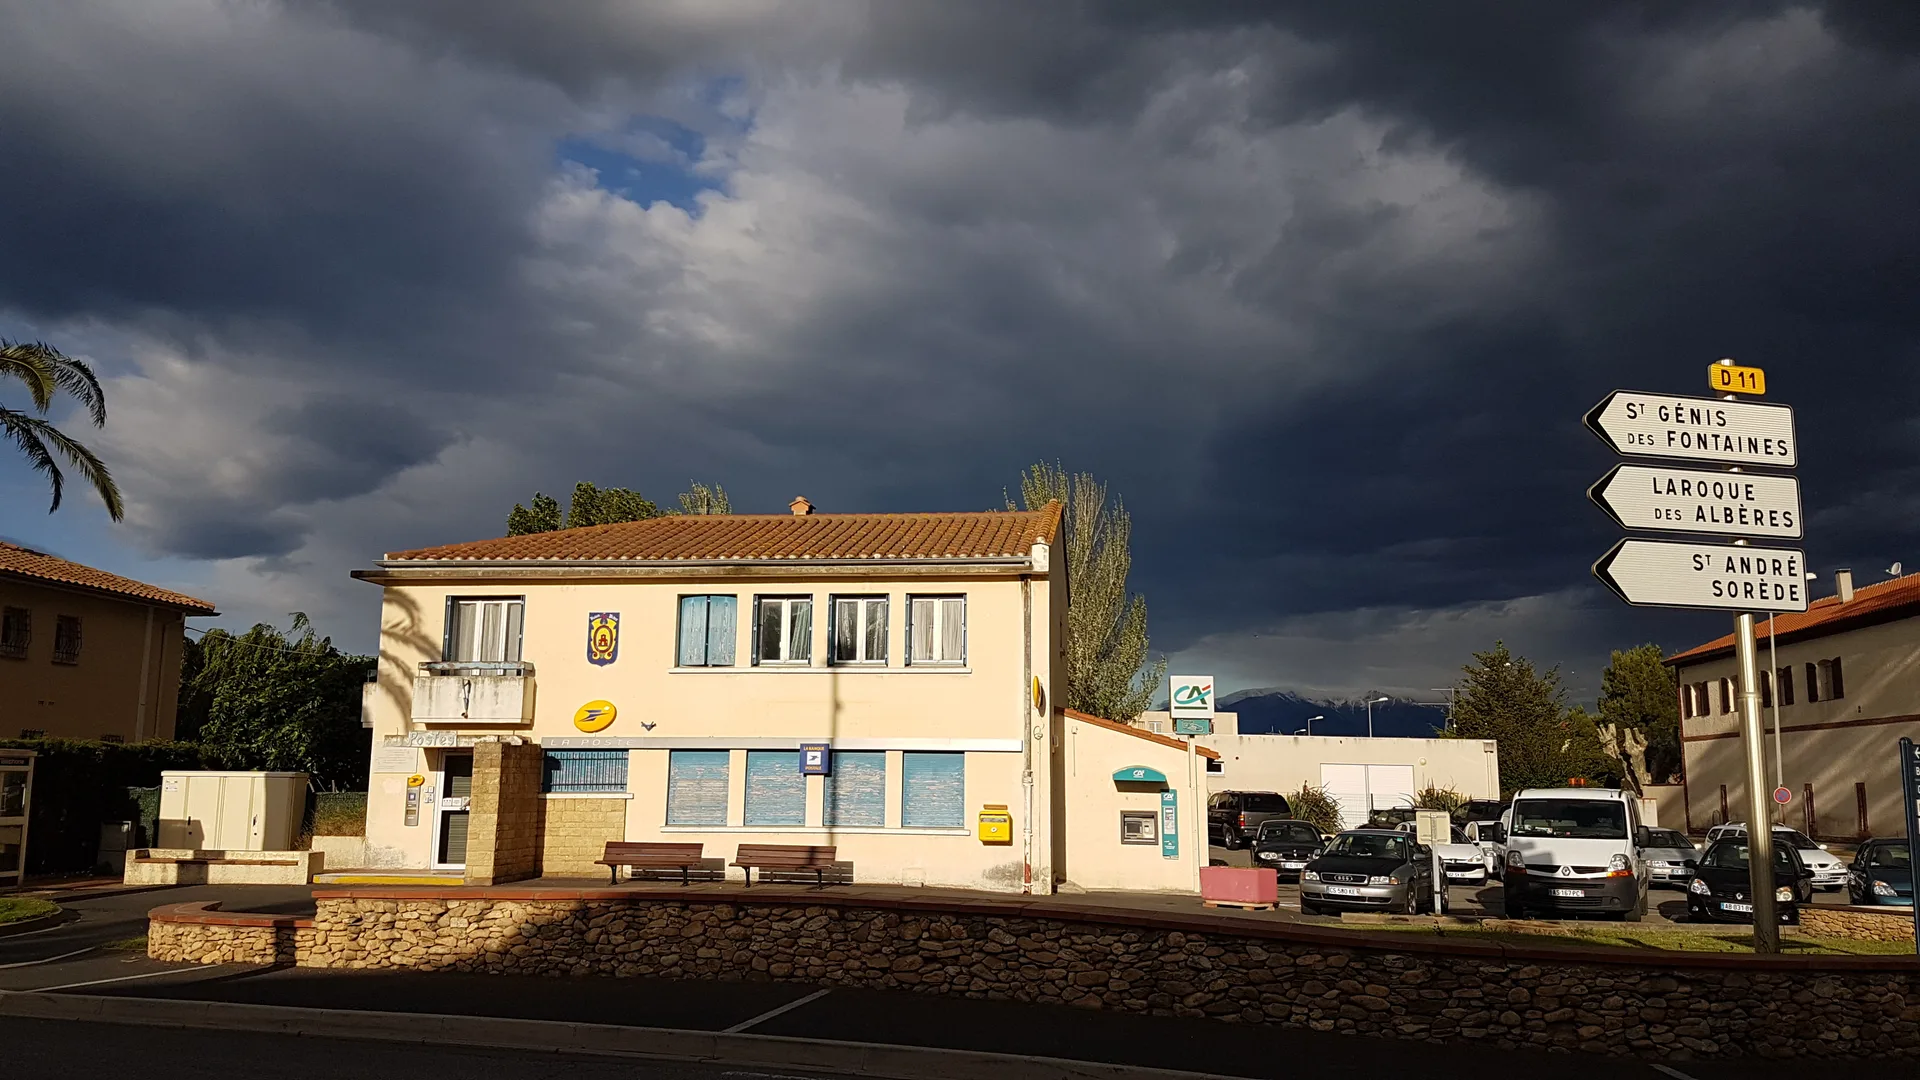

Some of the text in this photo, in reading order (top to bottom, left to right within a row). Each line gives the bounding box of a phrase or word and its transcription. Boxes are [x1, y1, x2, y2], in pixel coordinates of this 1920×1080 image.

[1720, 369, 1756, 389] D 11
[1658, 403, 1727, 427] GÉNIS
[1627, 430, 1788, 457] DES FONTAINES
[1652, 477, 1755, 502] LAROQUE
[1654, 503, 1794, 529] DES ALBÈRES
[1725, 555, 1798, 578] ANDRÉ
[1712, 578, 1800, 602] SORÈDE
